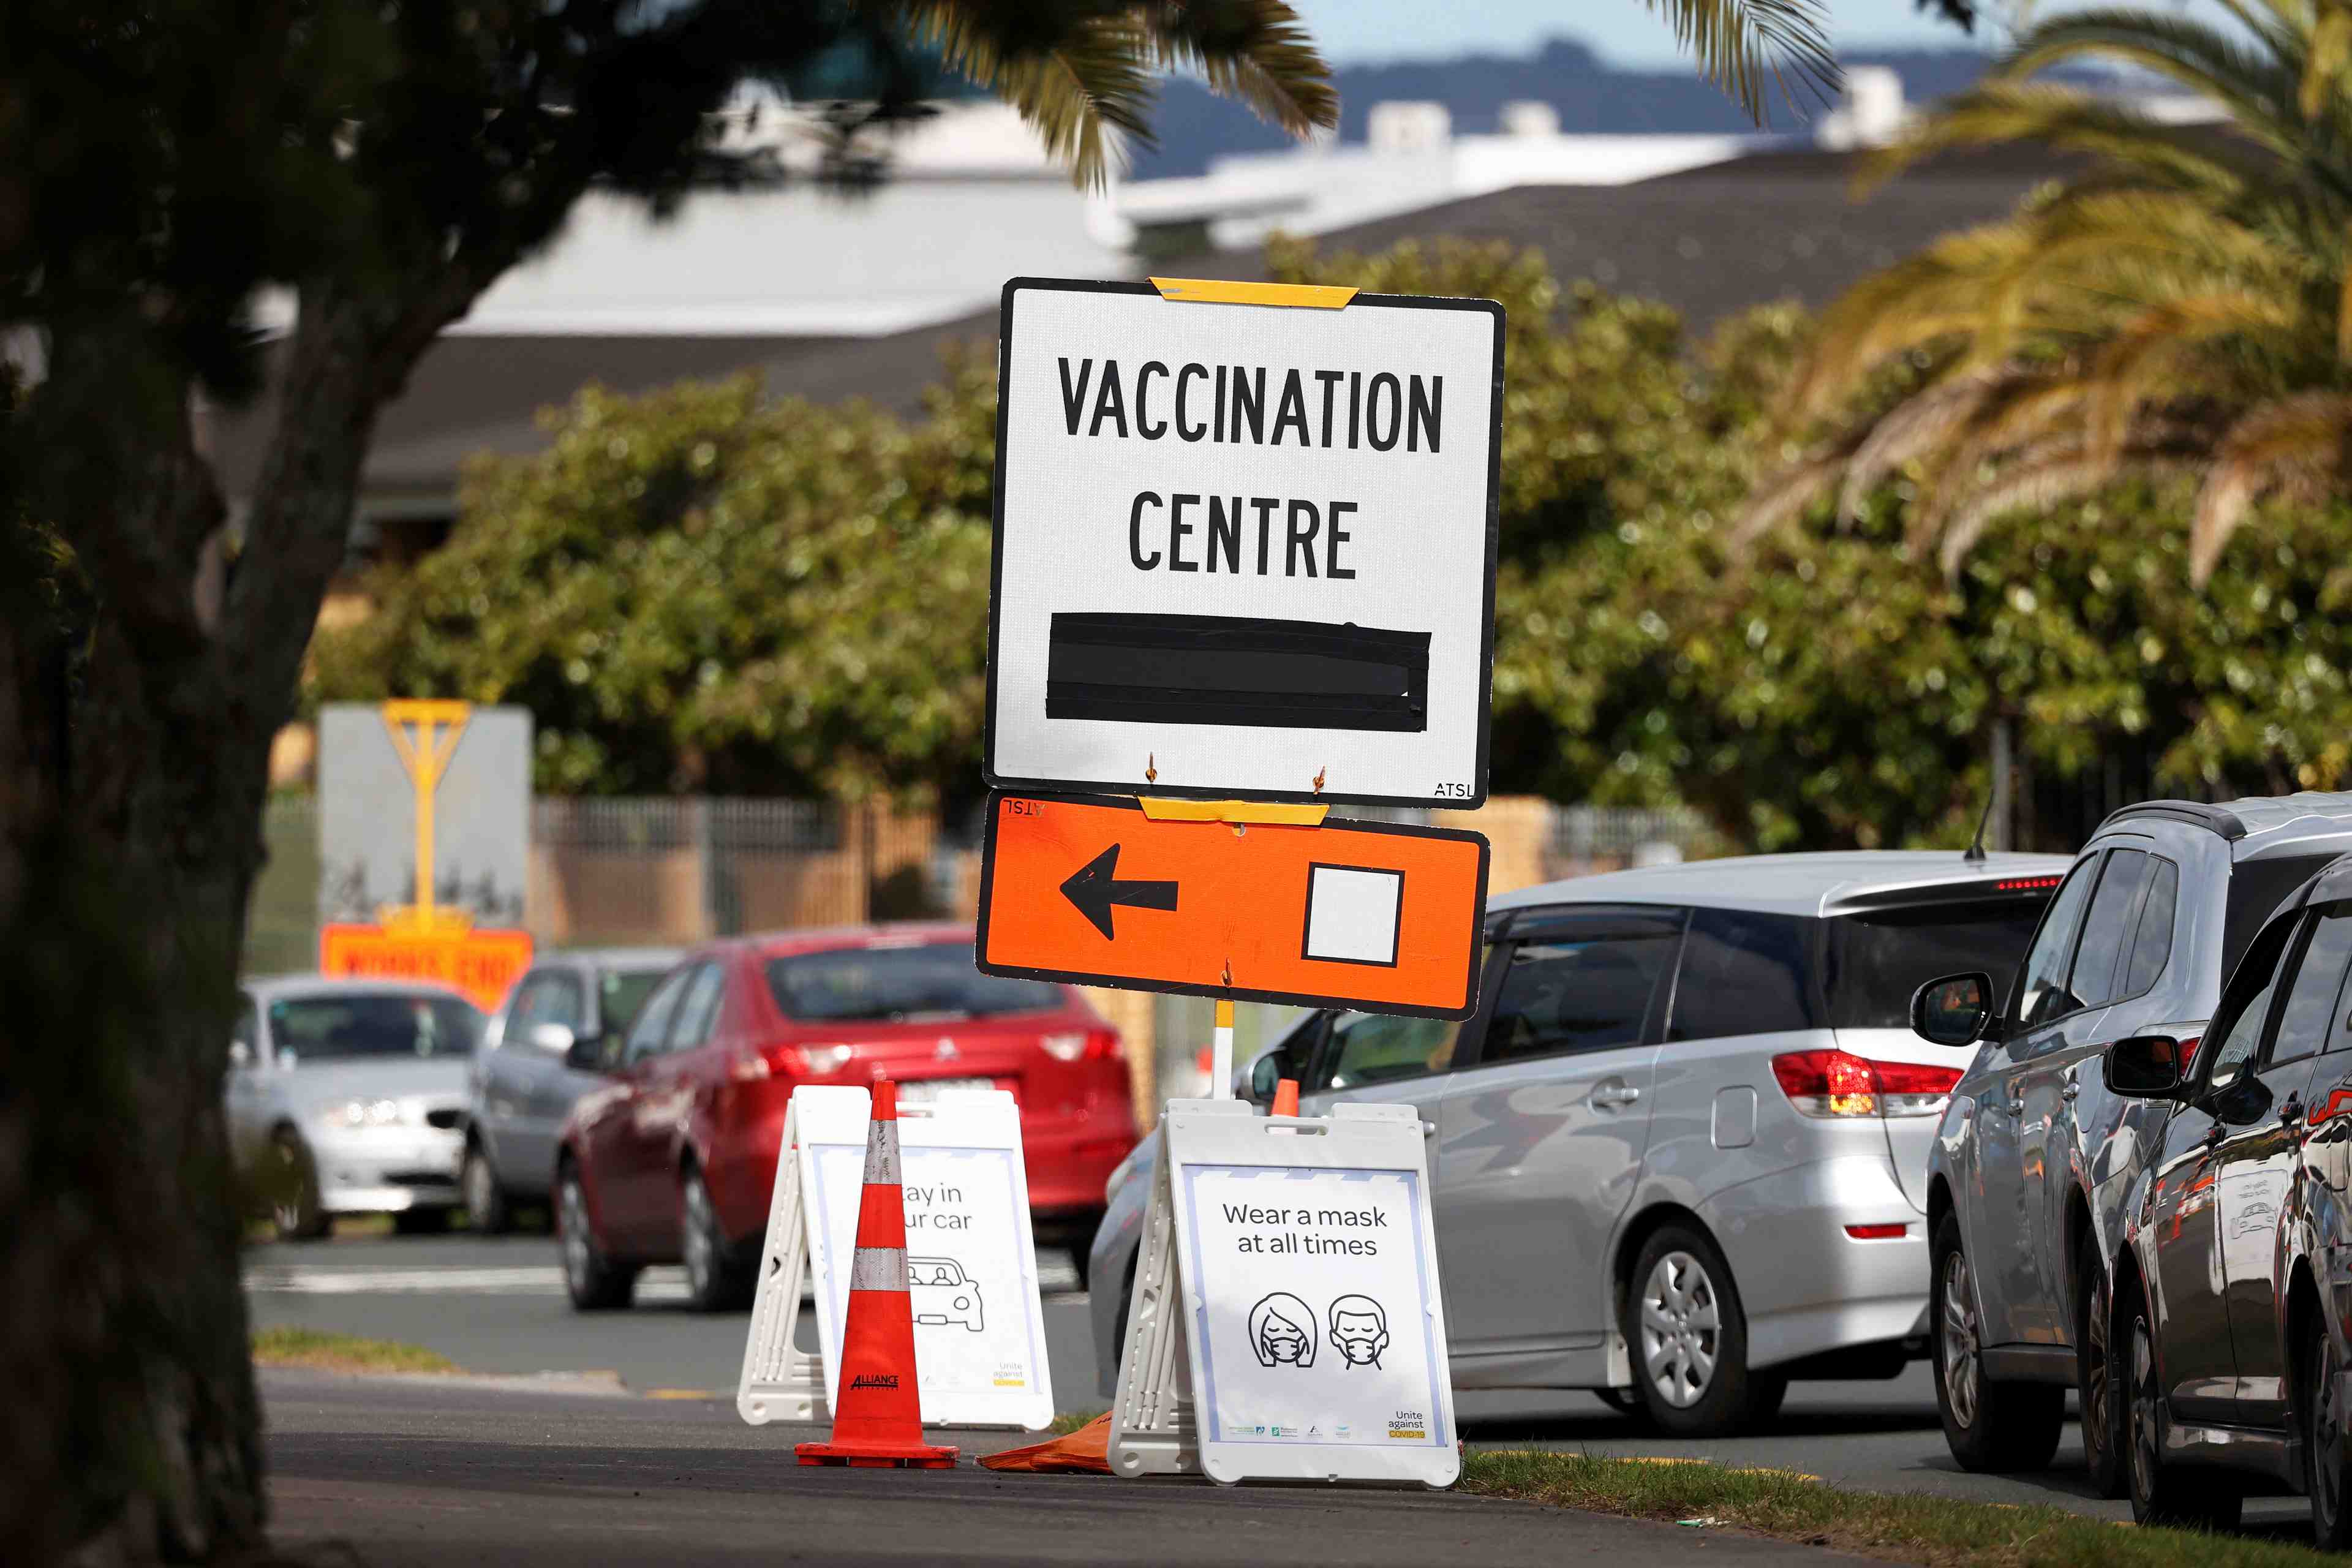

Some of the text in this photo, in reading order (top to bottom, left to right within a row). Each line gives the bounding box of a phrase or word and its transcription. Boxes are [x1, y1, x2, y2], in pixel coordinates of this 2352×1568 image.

[1058, 357, 1443, 453] VACCINATION
[1129, 491, 1358, 579] CENTRE
[1434, 783, 1476, 797] ATSL
[903, 1182, 962, 1207] ay in
[905, 1214, 973, 1229] ur car
[1223, 1204, 1387, 1227] Wear a mask
[1238, 1232, 1377, 1256] at all times
[850, 1374, 899, 1390] ALLIANCE
[1388, 1419, 1424, 1430] against
[1396, 1411, 1423, 1419] Unite
